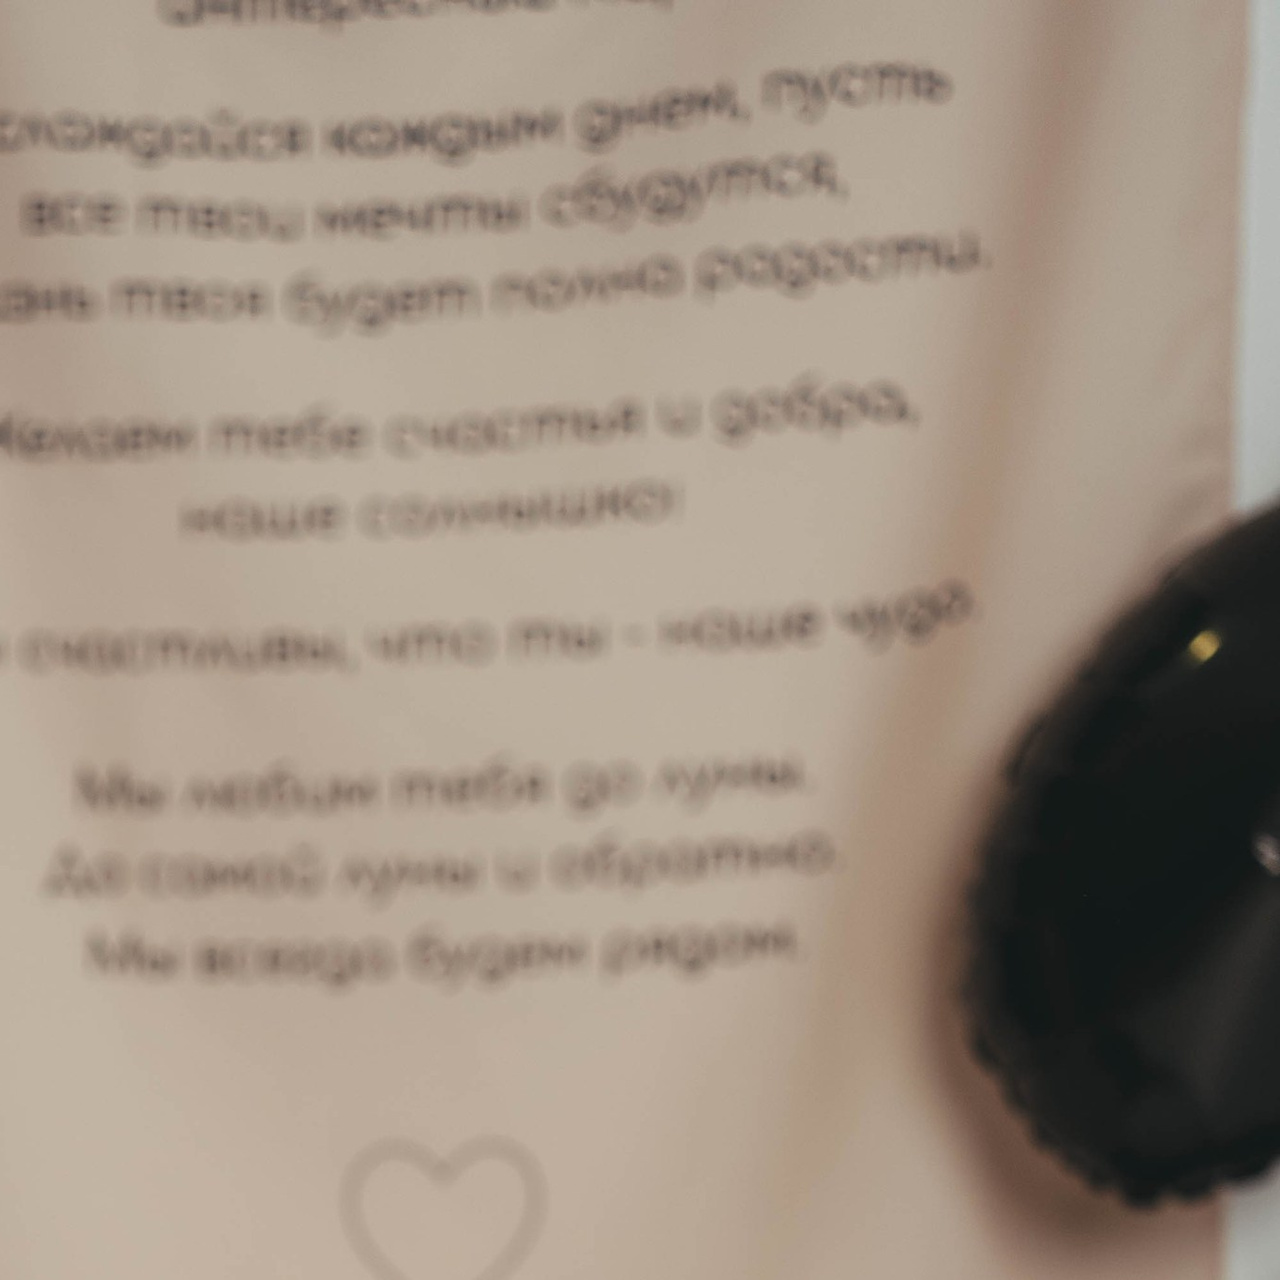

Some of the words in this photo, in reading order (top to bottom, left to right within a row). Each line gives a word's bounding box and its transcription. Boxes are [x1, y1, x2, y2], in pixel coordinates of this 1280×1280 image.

[323, 109, 563, 167] каждым
[762, 61, 953, 122] пусть
[20, 193, 126, 237] все
[136, 195, 305, 243] твои
[314, 194, 529, 240] мечты
[110, 278, 272, 322] твоя
[283, 273, 481, 336] будет
[490, 254, 685, 312] полна
[209, 406, 372, 459] тебе
[383, 397, 646, 458] счастья
[656, 399, 703, 438] и
[179, 498, 347, 542] наше
[366, 621, 498, 666] что
[507, 618, 610, 660] ты
[659, 604, 824, 652] наше
[73, 764, 171, 818] Мы
[181, 762, 381, 818] любим
[390, 757, 553, 811] тебя
[562, 762, 644, 819] до
[337, 855, 485, 908] луны
[493, 854, 542, 894] и
[84, 932, 184, 980] Мы
[406, 927, 590, 989] будем
